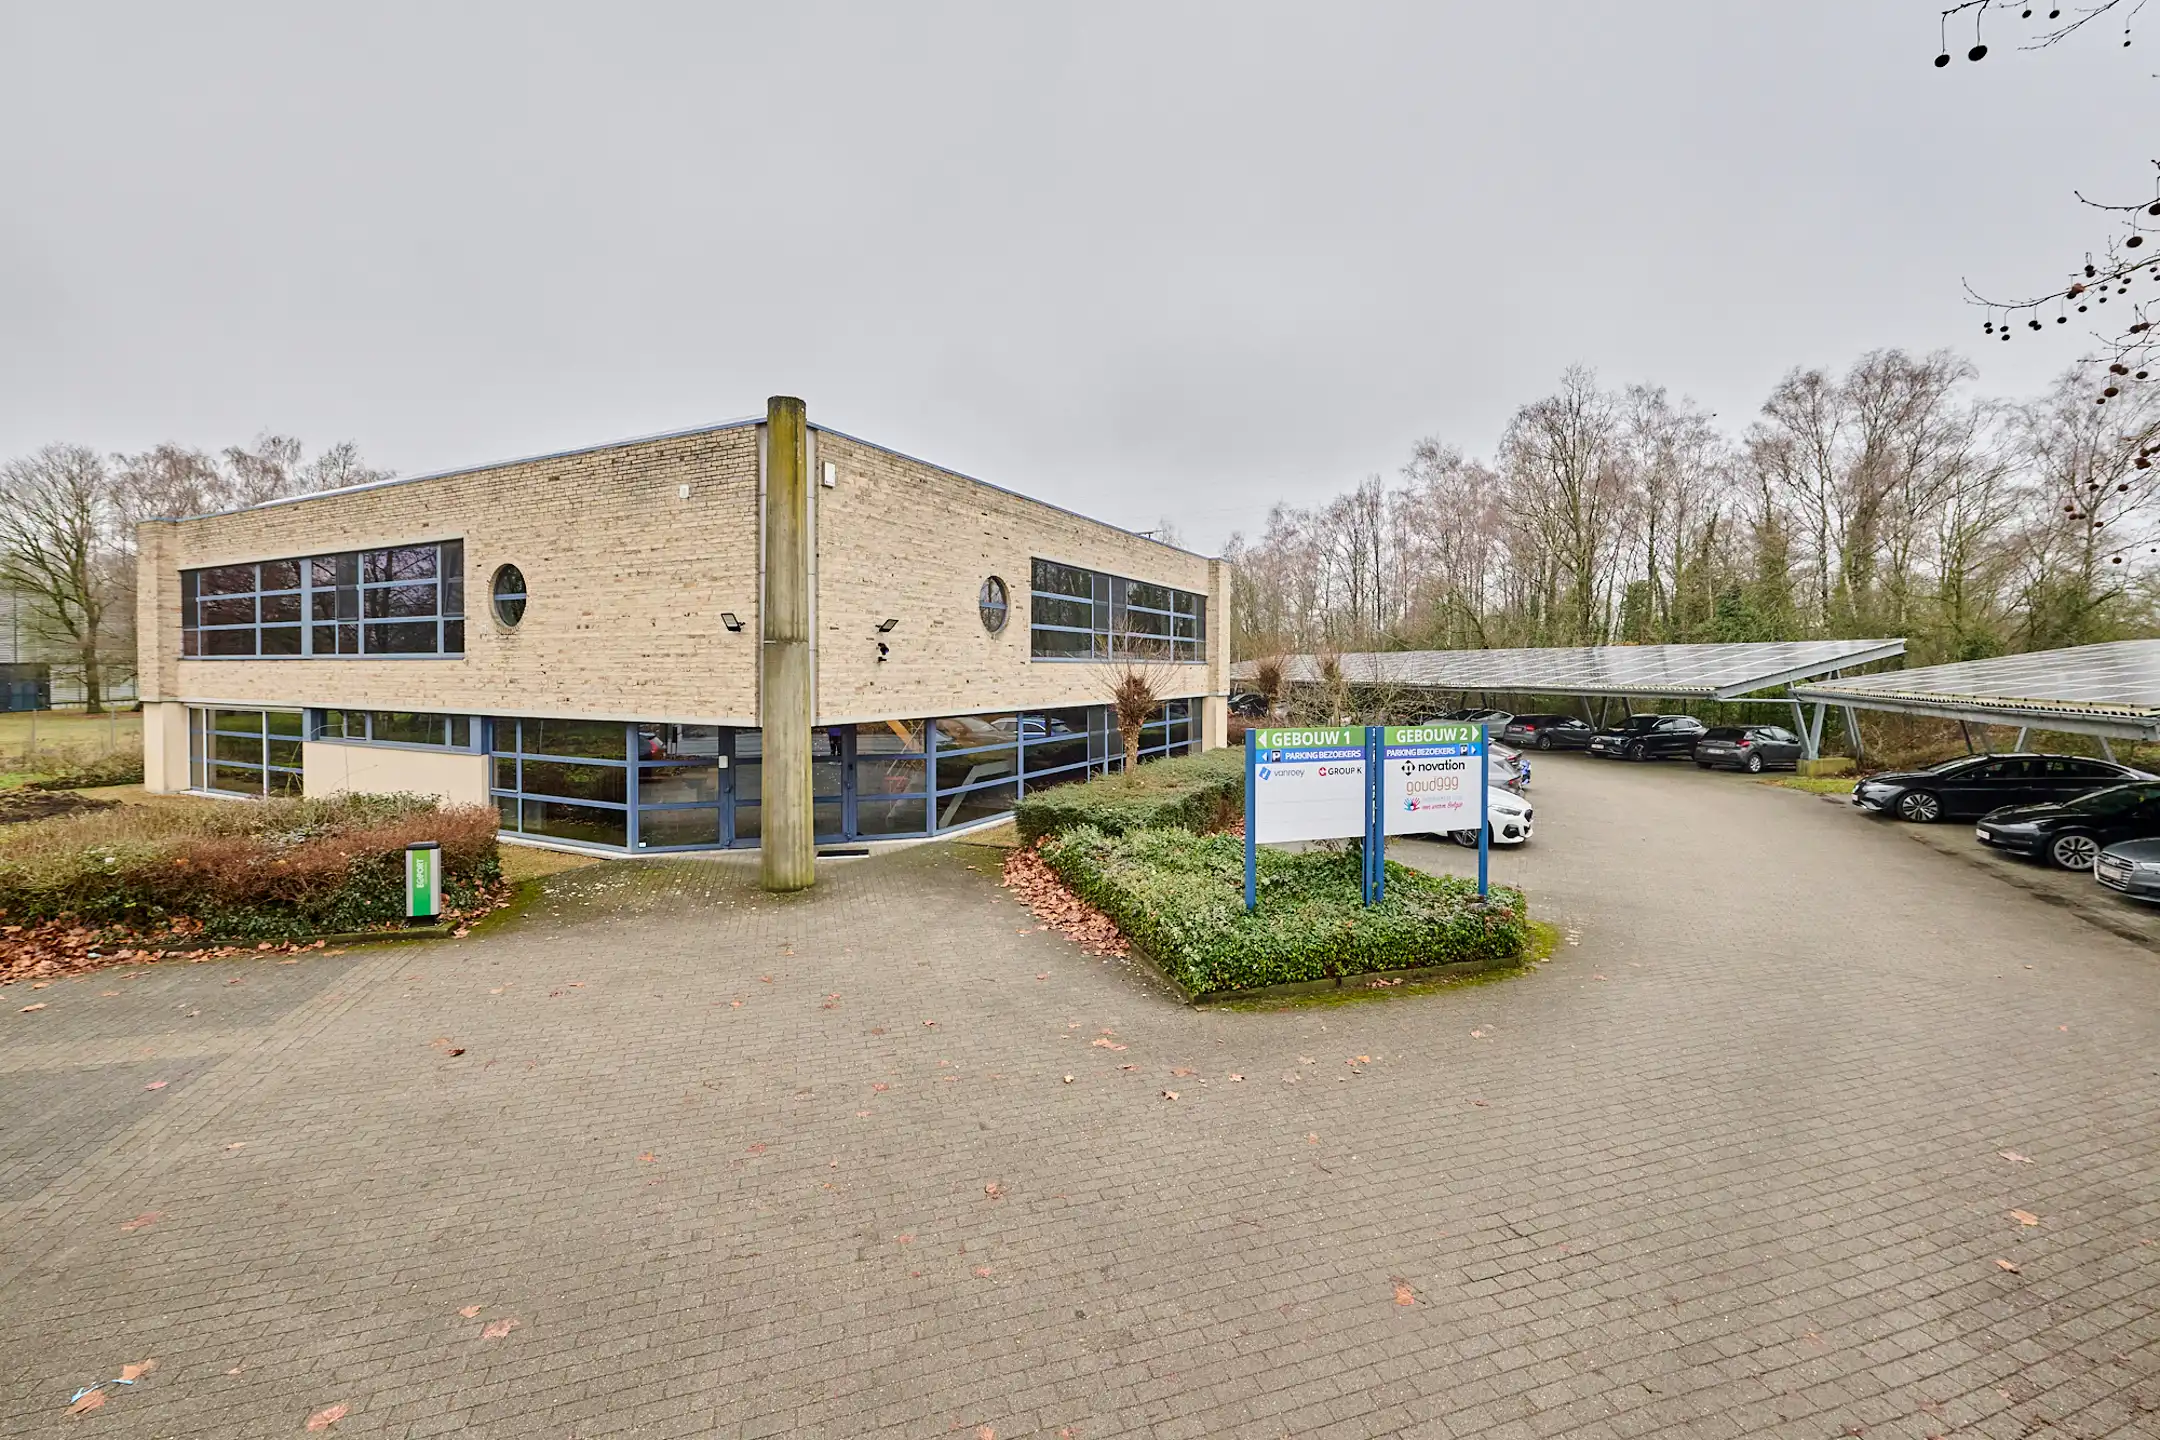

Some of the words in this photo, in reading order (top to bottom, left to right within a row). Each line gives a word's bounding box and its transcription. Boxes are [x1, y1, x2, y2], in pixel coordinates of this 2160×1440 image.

[1272, 731, 1340, 747] GEBOUW
[1343, 730, 1351, 745] 1
[1396, 728, 1457, 743] GEBOUW
[1459, 727, 1468, 741] 2
[1285, 751, 1318, 760] PARKING
[1319, 750, 1362, 759] BEZOEKERS
[1386, 748, 1417, 757] PARKING
[1417, 747, 1456, 756] BEZOEKERS
[1418, 758, 1466, 772] novation
[1274, 769, 1305, 778] vanroey
[1328, 767, 1355, 776] GROUP
[1356, 766, 1363, 775] K
